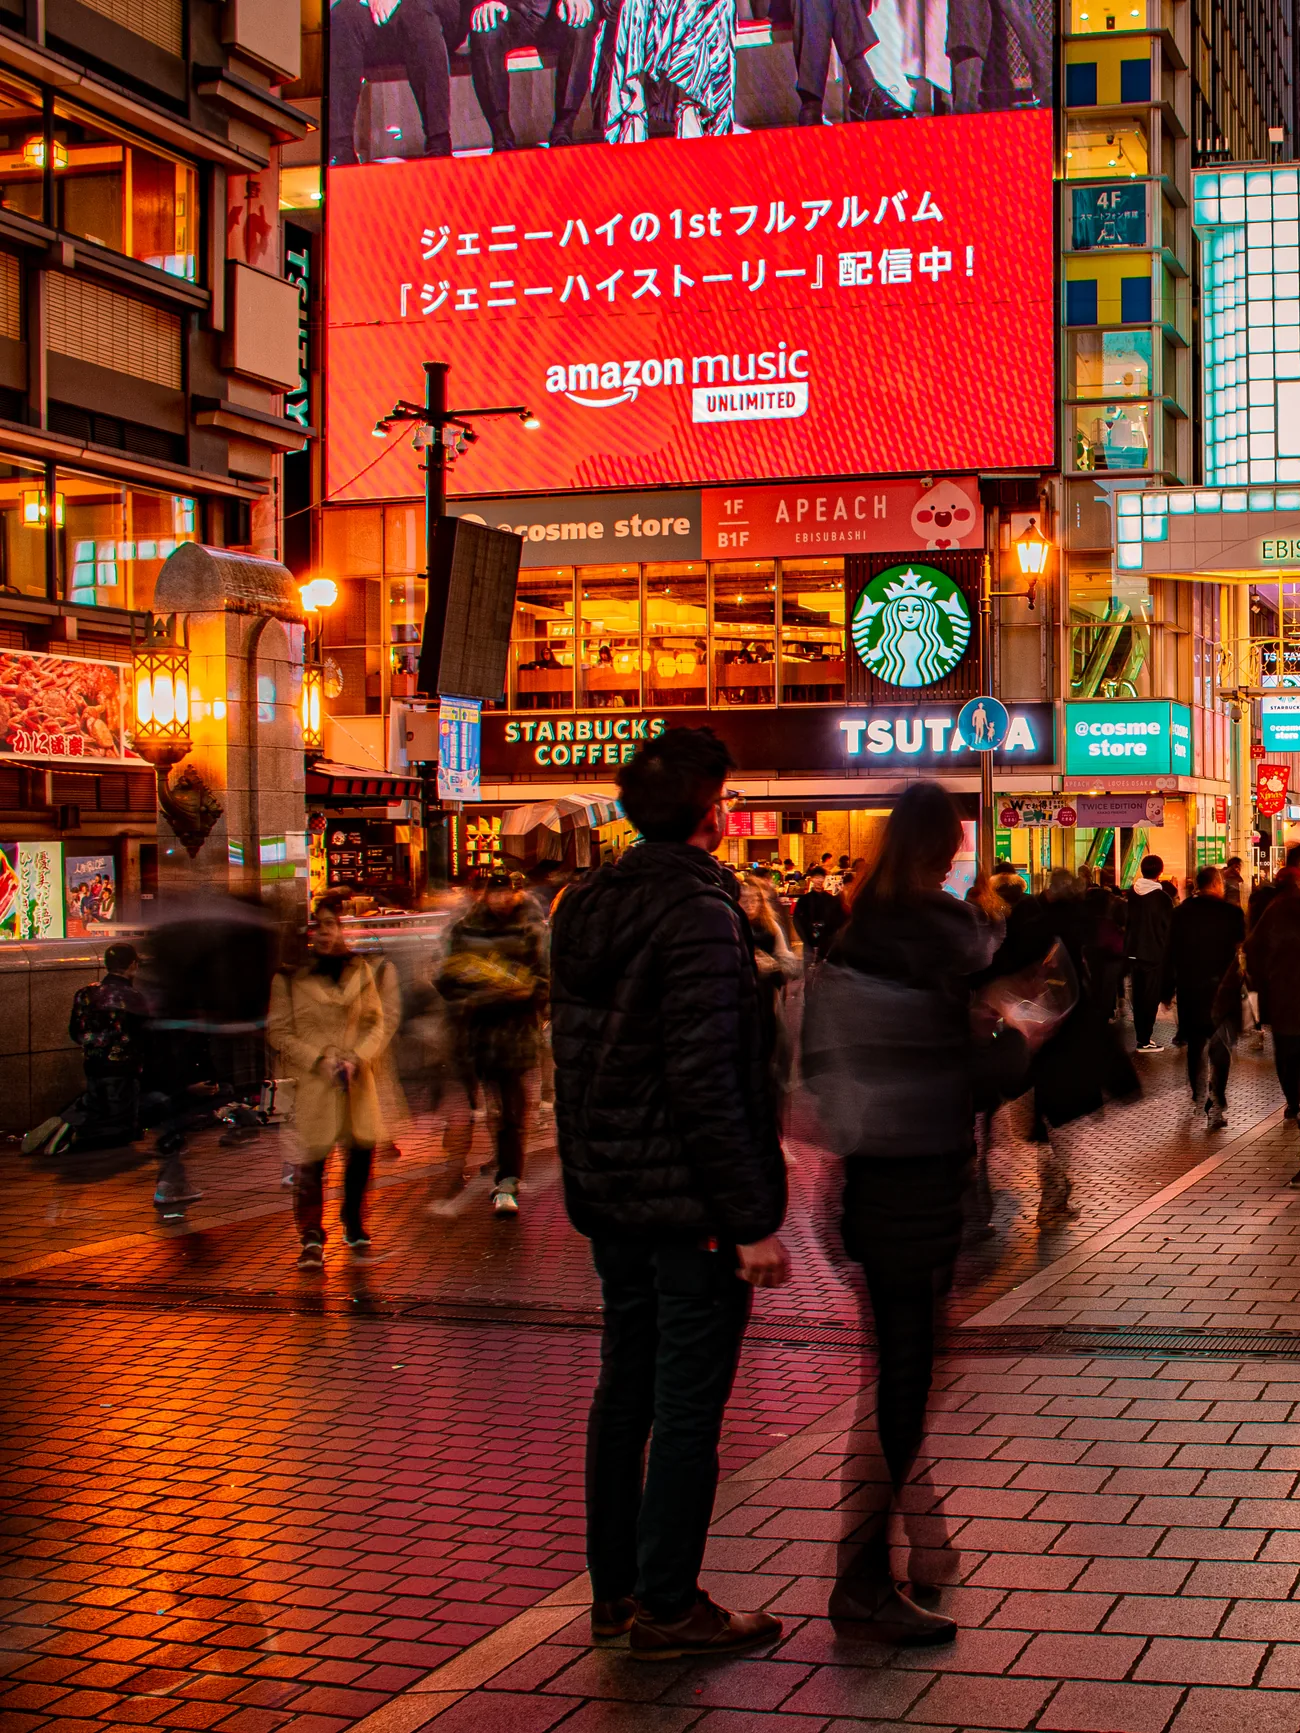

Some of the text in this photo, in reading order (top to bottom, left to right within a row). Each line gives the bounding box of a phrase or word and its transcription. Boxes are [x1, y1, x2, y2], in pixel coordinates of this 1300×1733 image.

[1097, 191, 1121, 209] 4F
[421, 190, 944, 260] ジェニーハイの1stフルアルバム
[546, 341, 809, 394] amazon music
[706, 391, 796, 413] UNLIMITED
[723, 499, 744, 514] 1F
[775, 495, 888, 523] APEACH
[614, 514, 691, 537] store
[717, 531, 750, 548] B1F
[795, 530, 867, 543] EBISUBASHI
[504, 718, 667, 743] STARBUCKS
[1075, 721, 1161, 736] @cosme
[1275, 732, 1299, 740] store
[13, 730, 84, 757] かに道楽
[1088, 739, 1148, 757] store
[534, 744, 637, 766] COFFEE
[1064, 780, 1090, 788] APEACH
[1131, 779, 1153, 787] OSAKA
[1259, 790, 1284, 801] Xmas
